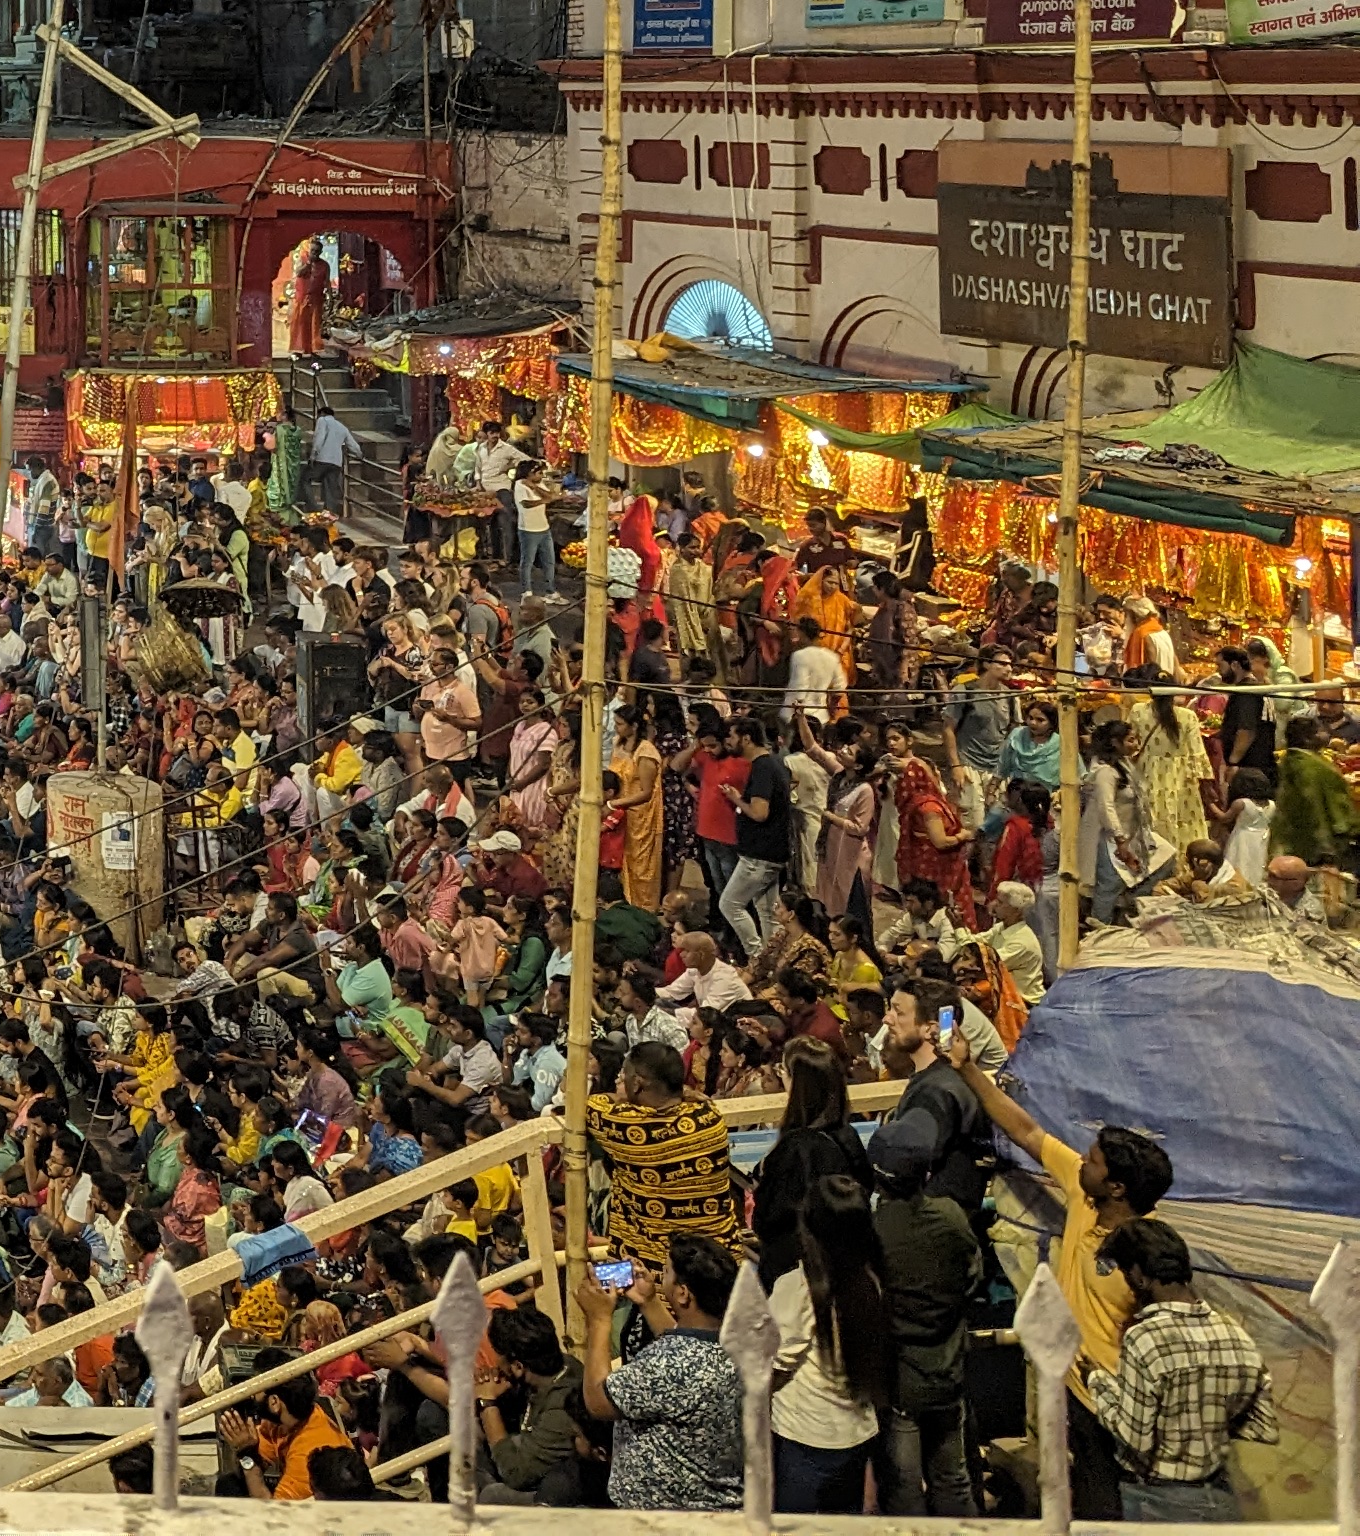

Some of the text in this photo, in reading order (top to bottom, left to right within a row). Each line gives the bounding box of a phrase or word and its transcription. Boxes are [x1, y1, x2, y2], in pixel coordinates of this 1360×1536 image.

[1019, 19, 1057, 35] पंजाब
[1111, 12, 1135, 32] बैंक
[1248, 16, 1293, 35] स्वागत
[1296, 7, 1316, 28] एवं
[271, 179, 286, 195] श्री
[1121, 229, 1185, 272] घाट
[1148, 293, 1212, 324] GHAT
